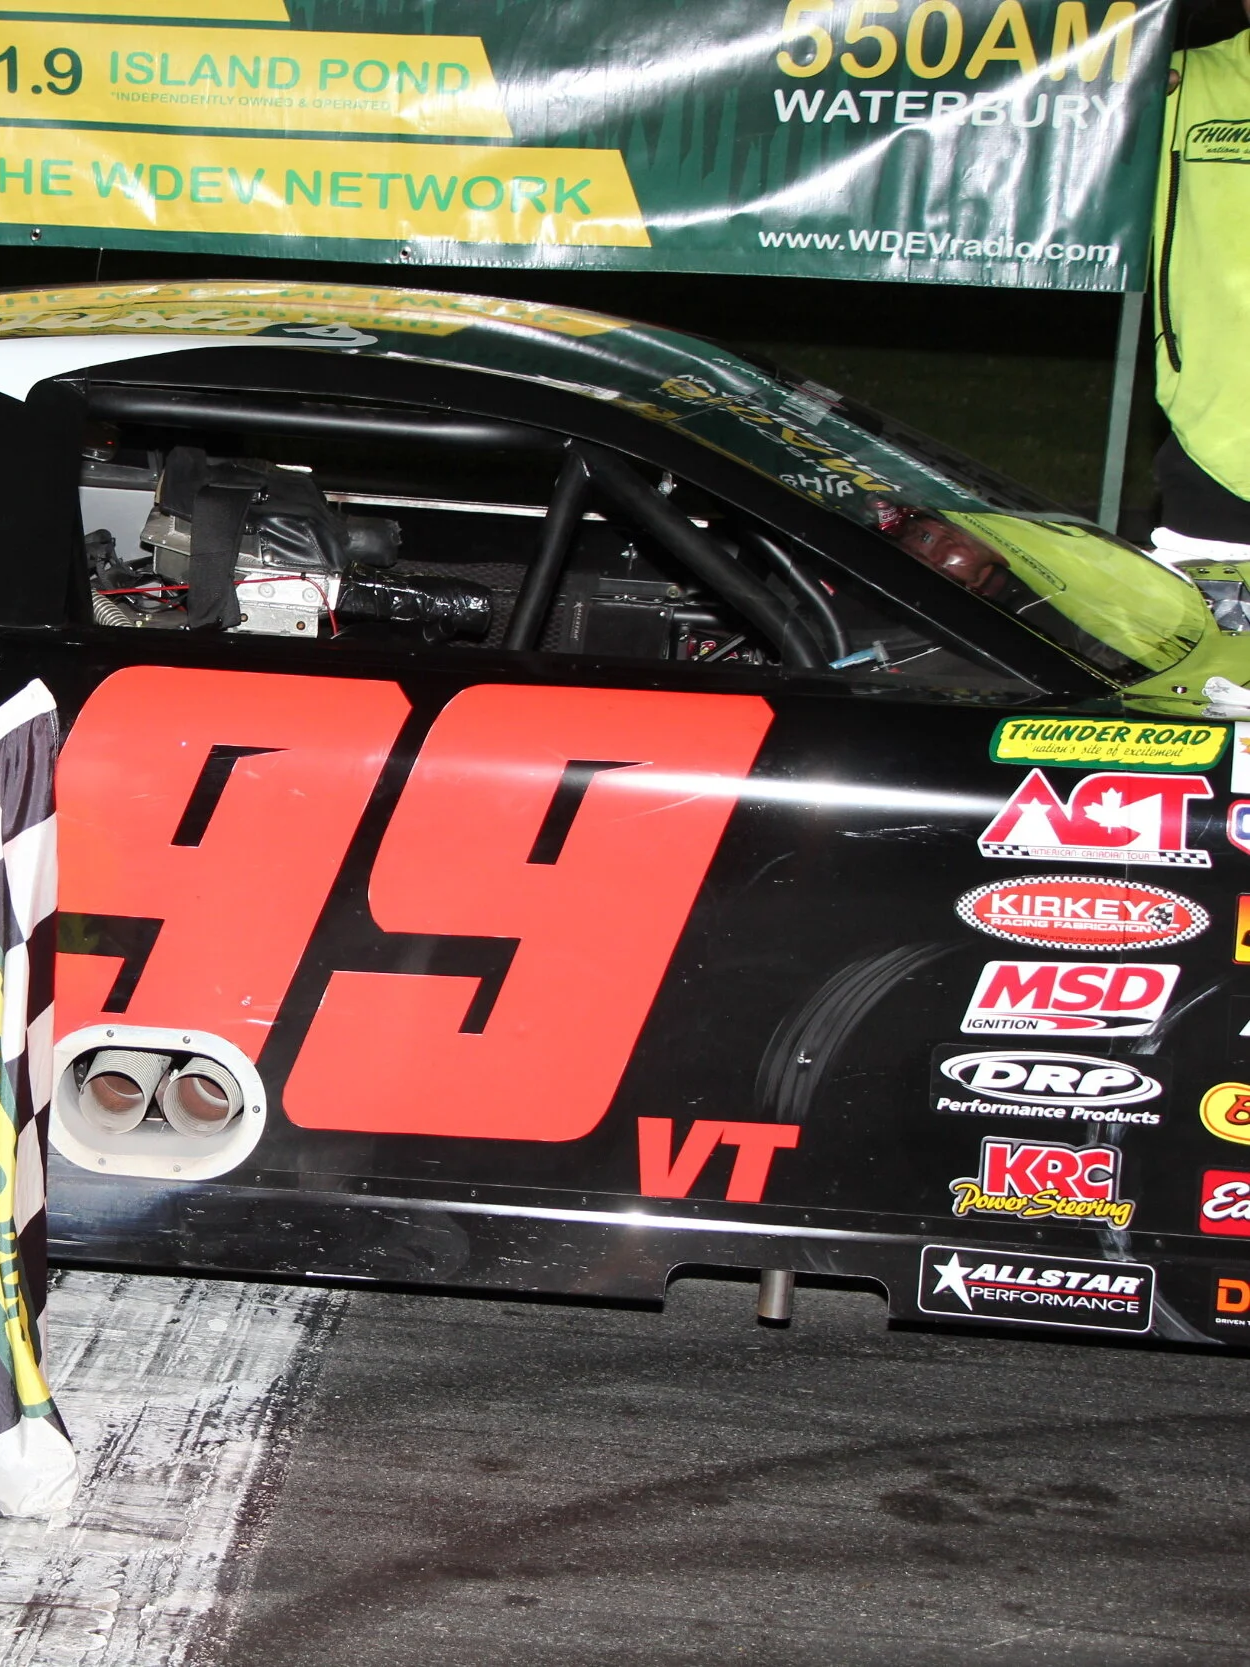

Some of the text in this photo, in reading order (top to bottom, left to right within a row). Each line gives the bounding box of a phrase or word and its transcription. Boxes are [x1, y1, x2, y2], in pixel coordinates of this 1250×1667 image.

[776, 0, 1137, 82] 550AM
[110, 51, 301, 90] ISLAND
[319, 58, 471, 96] POND
[773, 89, 1121, 129] WATERBURY
[91, 162, 266, 206] WDEV
[284, 170, 593, 215] NETWORK
[758, 228, 1119, 264] www.WDEVradio.com
[1009, 723, 1211, 745] THUNDER ROAD
[1081, 743, 1102, 755] site
[1107, 745, 1118, 757] of
[981, 773, 1211, 850] ACT
[1031, 848, 1150, 860] AMERICAN CANADIAN TOUR
[53, 666, 774, 1141] 99
[991, 894, 1151, 920] KIRKEY
[991, 918, 1152, 932] RACING FABRICATION
[977, 965, 1165, 1011] MSD
[967, 1018, 1038, 1030] IGNITION
[971, 1062, 1135, 1095] DRP
[937, 1098, 1160, 1125] Performance Products
[638, 1117, 800, 1202] VT
[986, 1143, 1115, 1200] KRC
[953, 1182, 1134, 1226] Power Steering
[970, 1263, 1140, 1294] ALLSTAR
[970, 1287, 1140, 1313] PERFORMANCE
